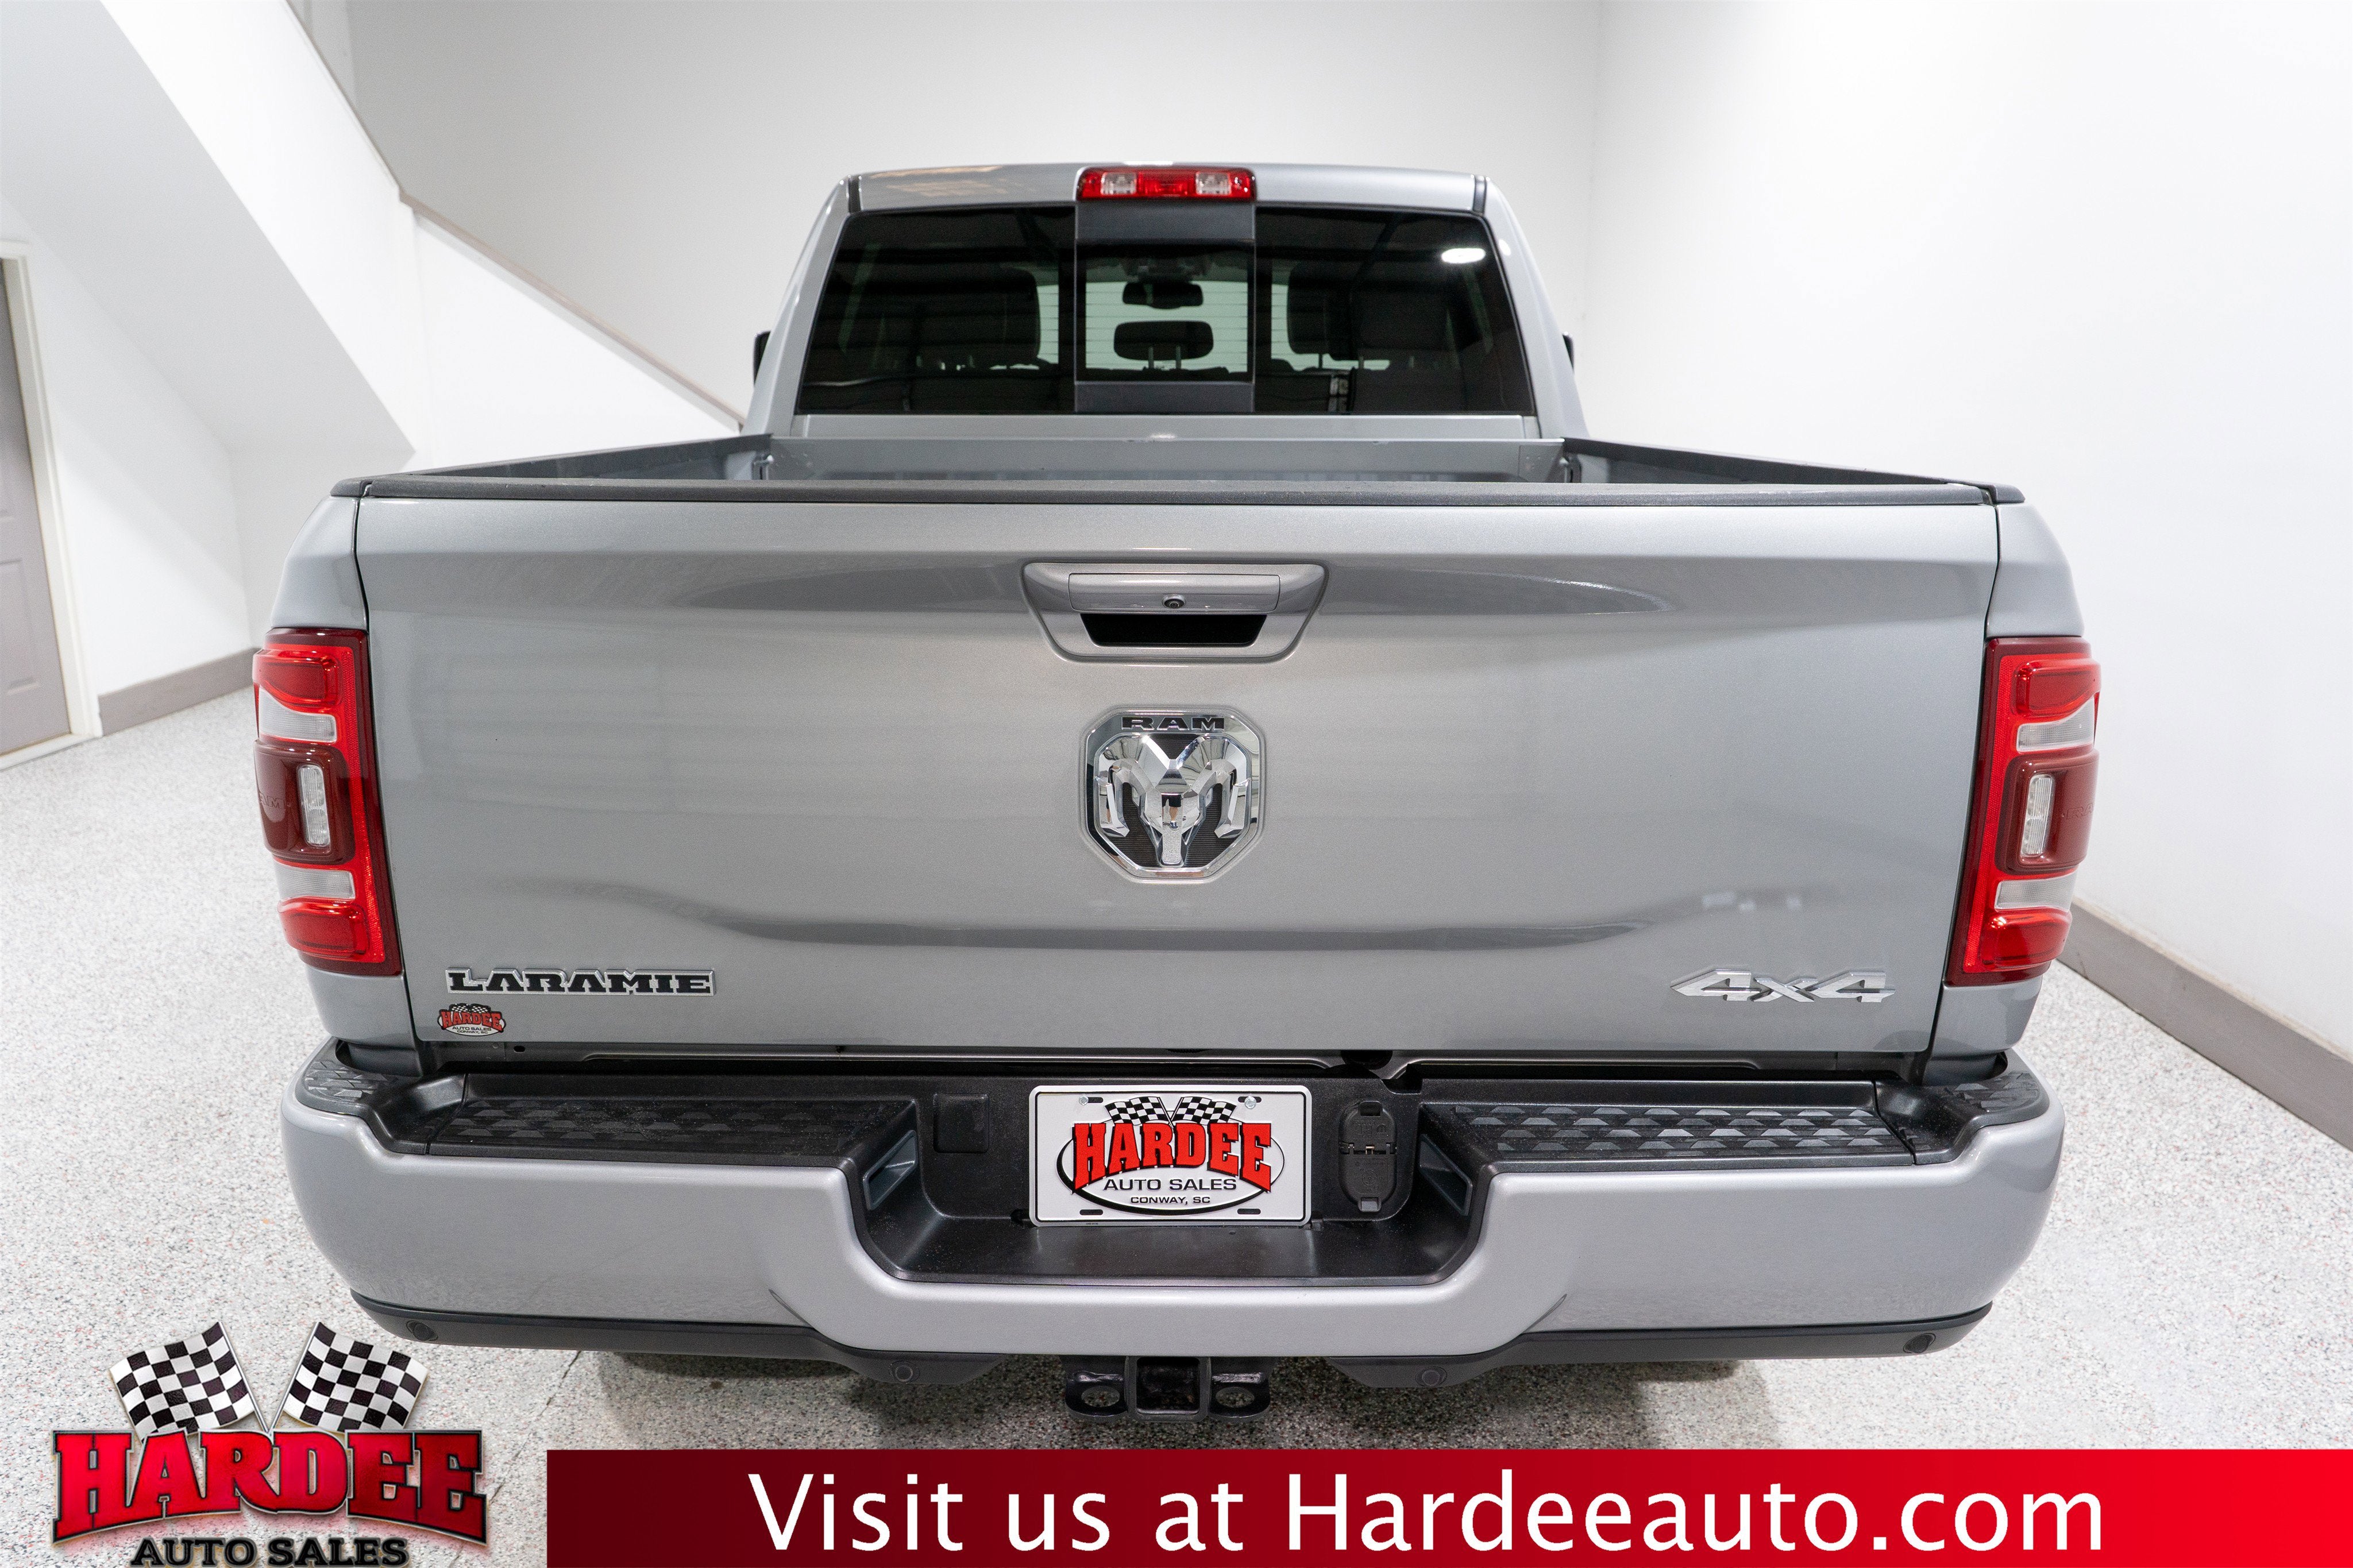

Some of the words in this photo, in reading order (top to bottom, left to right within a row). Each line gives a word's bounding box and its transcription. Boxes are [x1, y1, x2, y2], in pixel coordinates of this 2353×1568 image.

[1121, 717, 1225, 731] RAM
[259, 793, 286, 810] AM
[445, 968, 716, 996] LARAMIE
[1671, 968, 1895, 1002] 4x4
[441, 1011, 503, 1032] HARDEE
[1072, 1123, 1272, 1194] HARDEE
[1103, 1179, 1161, 1191] AUTO
[1169, 1179, 1237, 1191] SALES
[1130, 1196, 1188, 1205] CONWAY,
